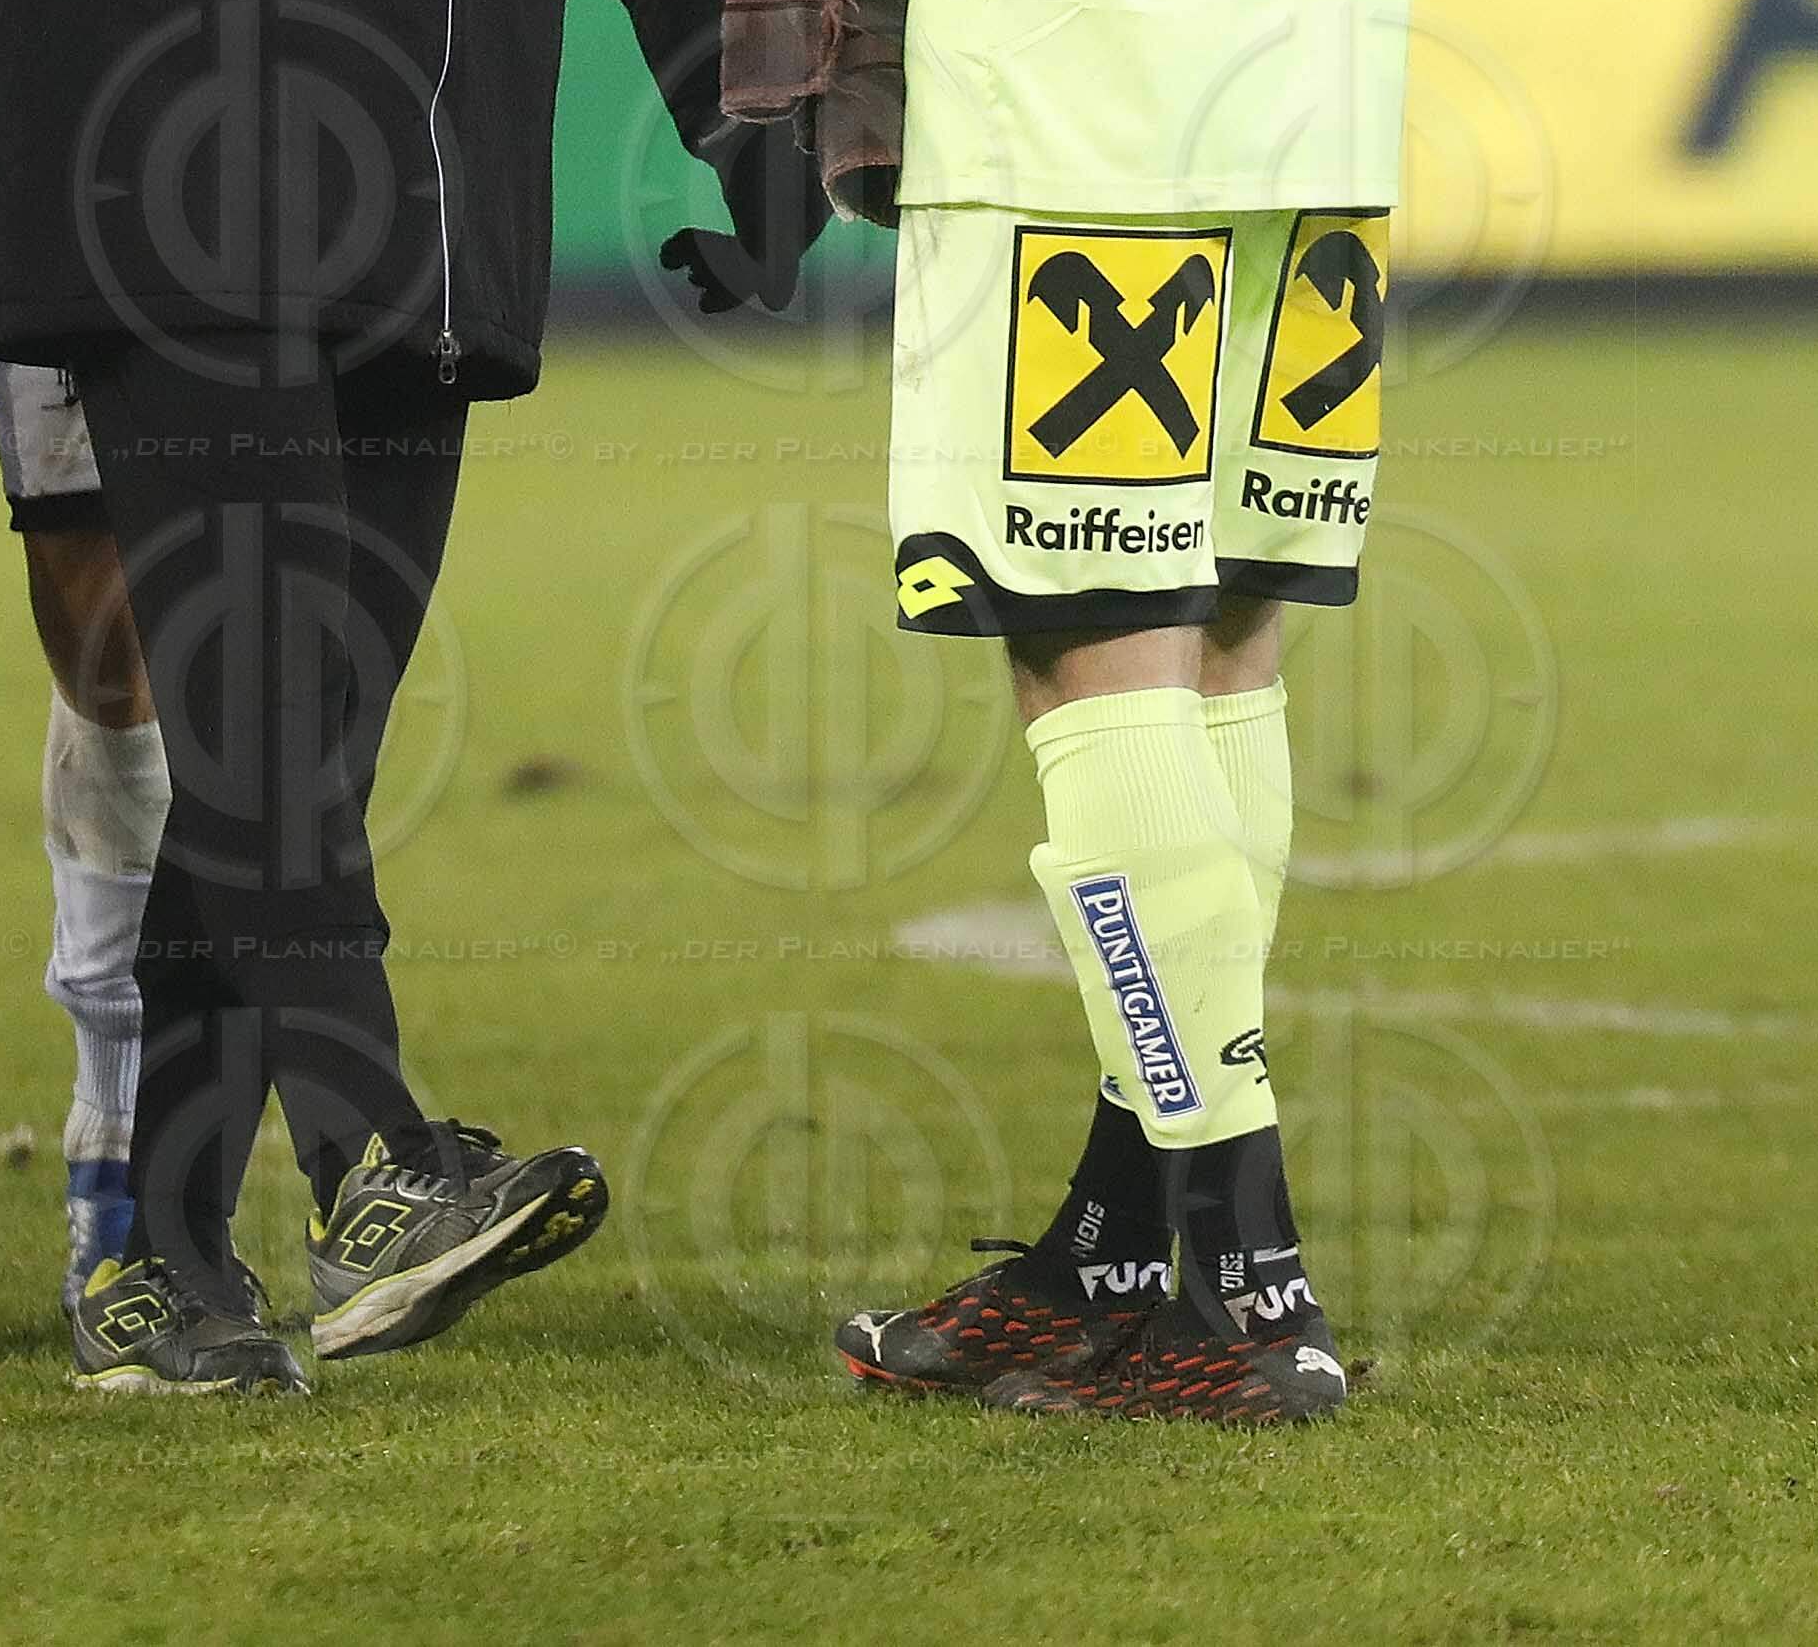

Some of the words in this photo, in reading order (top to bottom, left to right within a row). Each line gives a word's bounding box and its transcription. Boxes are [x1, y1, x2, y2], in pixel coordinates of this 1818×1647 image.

[1241, 469, 1371, 525] Raiffe
[1005, 503, 1204, 554] Raiffeisen
[1082, 888, 1188, 1105] PUNTIGAMER
